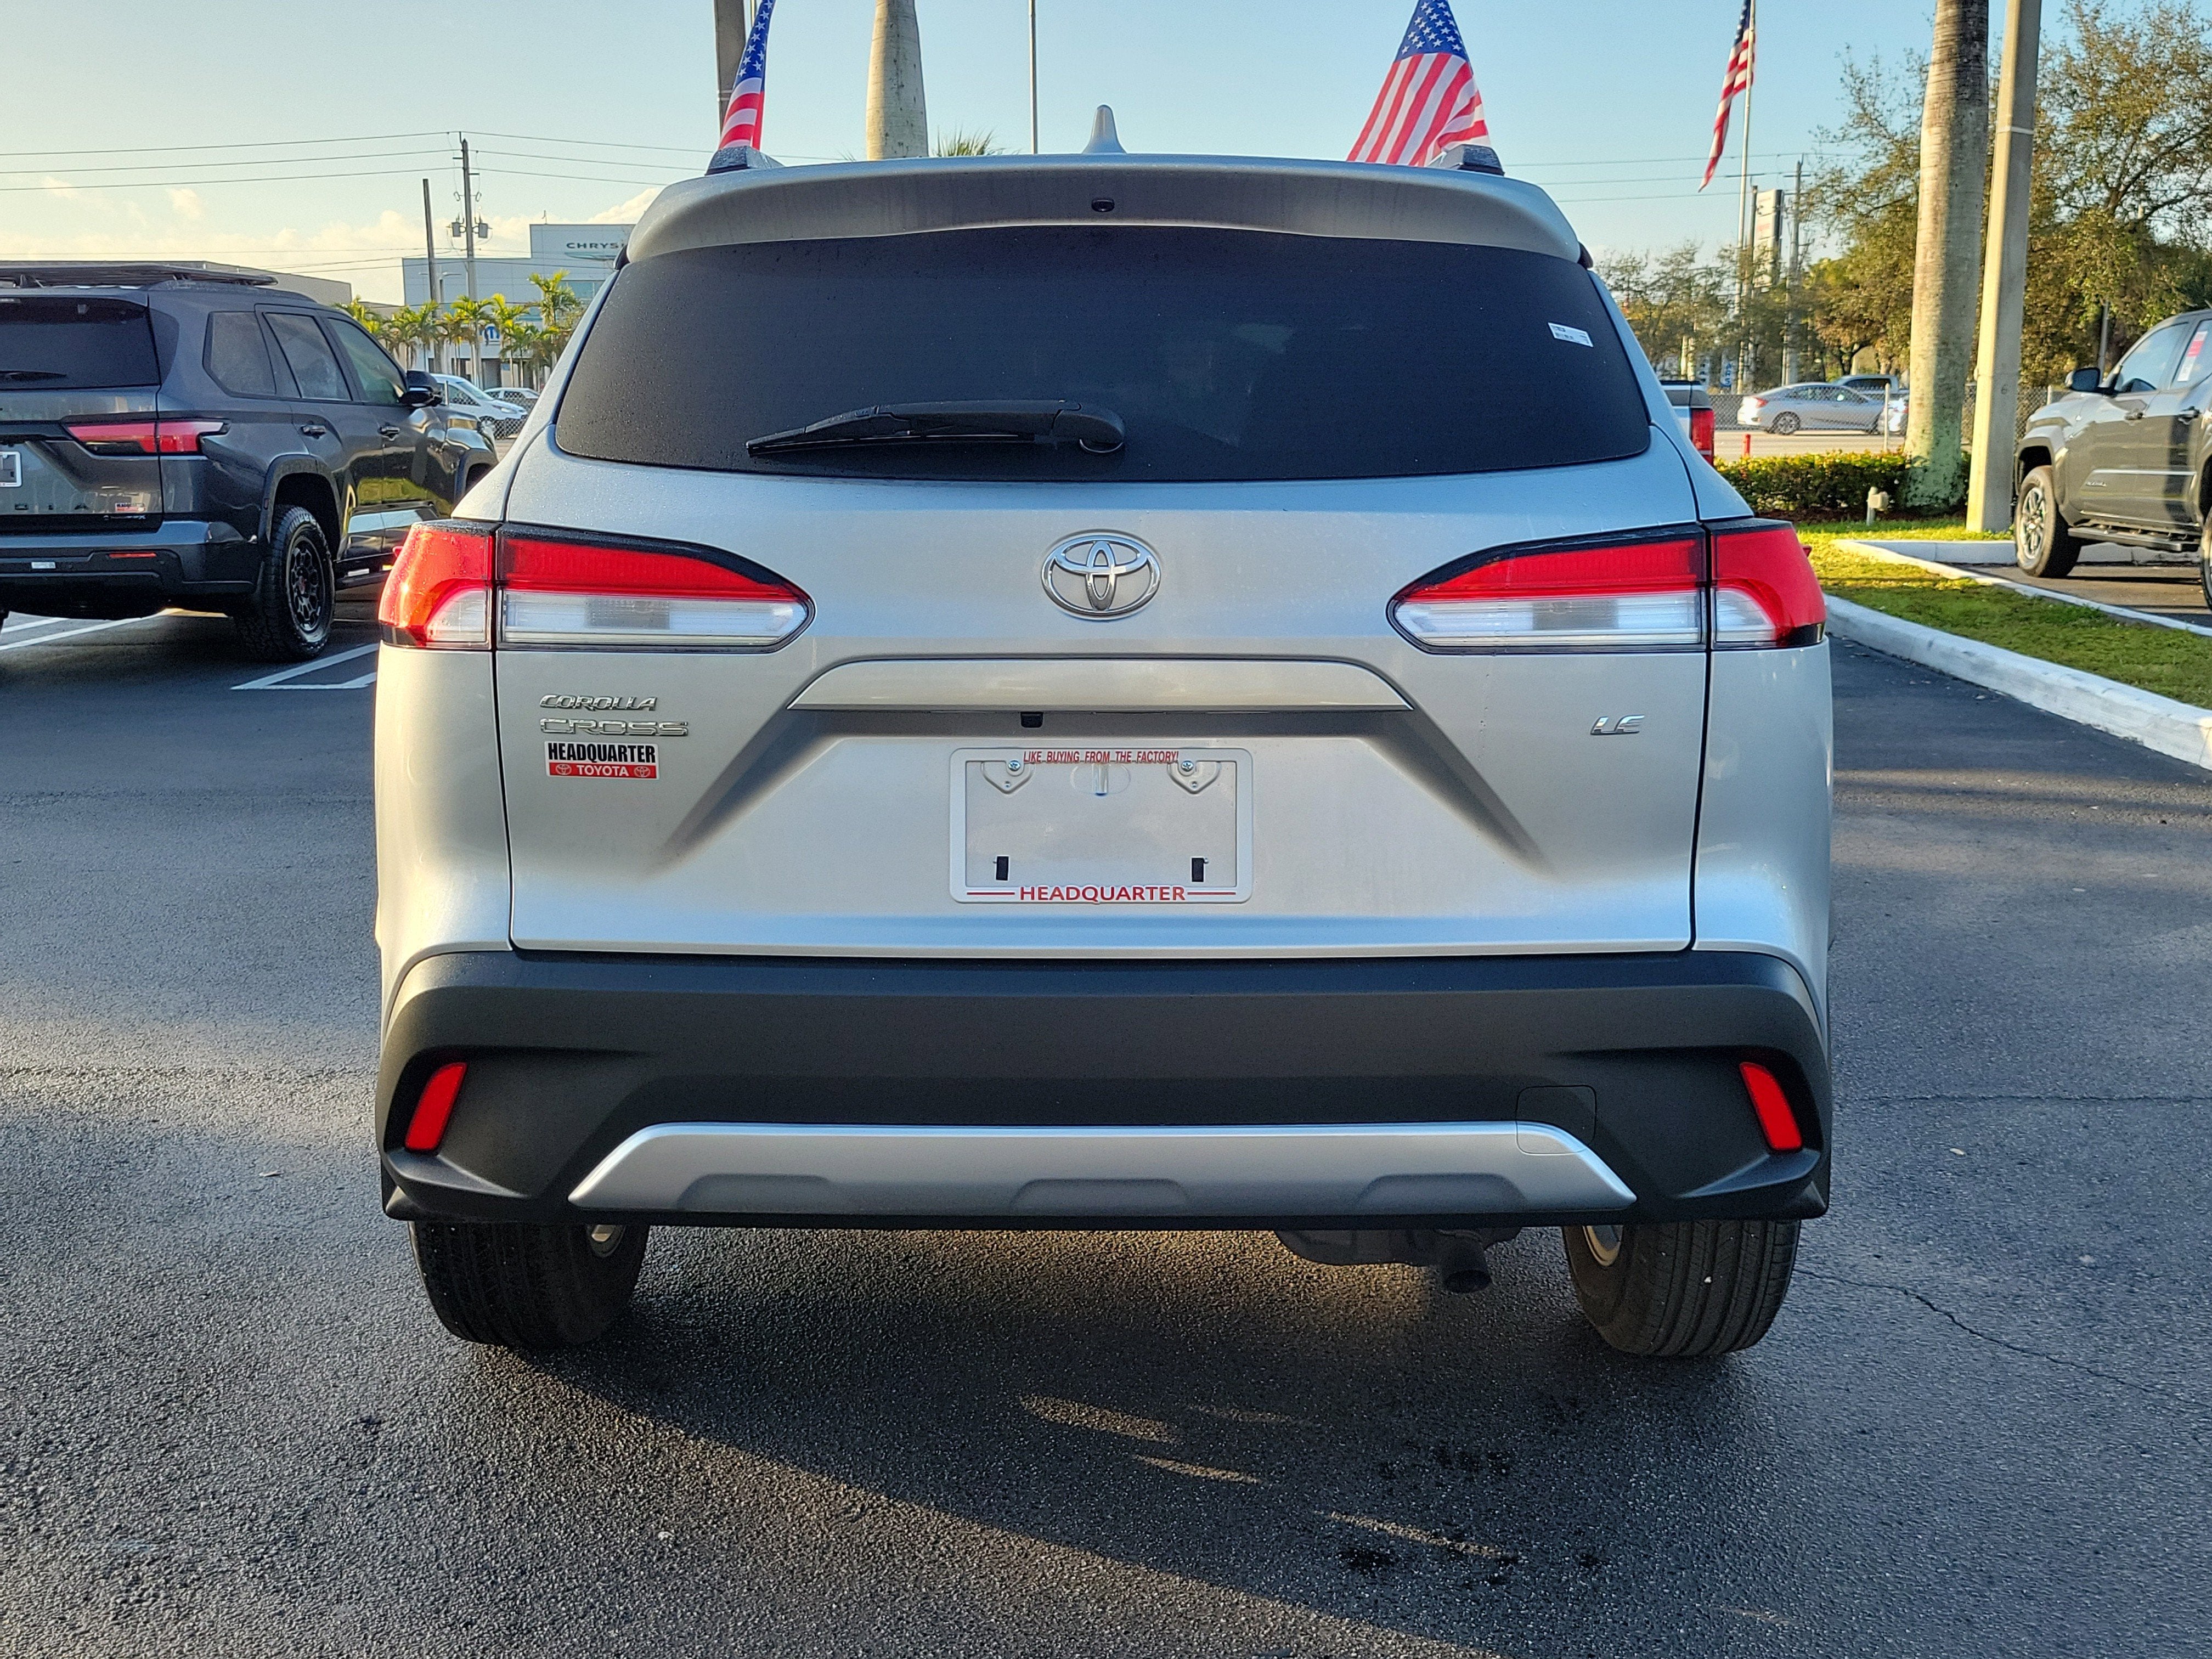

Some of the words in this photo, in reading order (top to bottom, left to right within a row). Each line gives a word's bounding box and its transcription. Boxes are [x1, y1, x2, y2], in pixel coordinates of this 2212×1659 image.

[539, 694, 657, 712] COROLLA
[539, 718, 689, 736] CROSS
[1590, 714, 1645, 735] LE
[548, 742, 656, 763] HEADQUARTER
[1023, 751, 1042, 762] LIKE
[1047, 751, 1080, 763] BUYING
[1085, 751, 1110, 763] FROM
[1115, 751, 1132, 763] THE
[1136, 751, 1179, 763] FACTORY!
[577, 765, 630, 777] TOYOTA
[1020, 886, 1186, 903] HEADQUARTER
